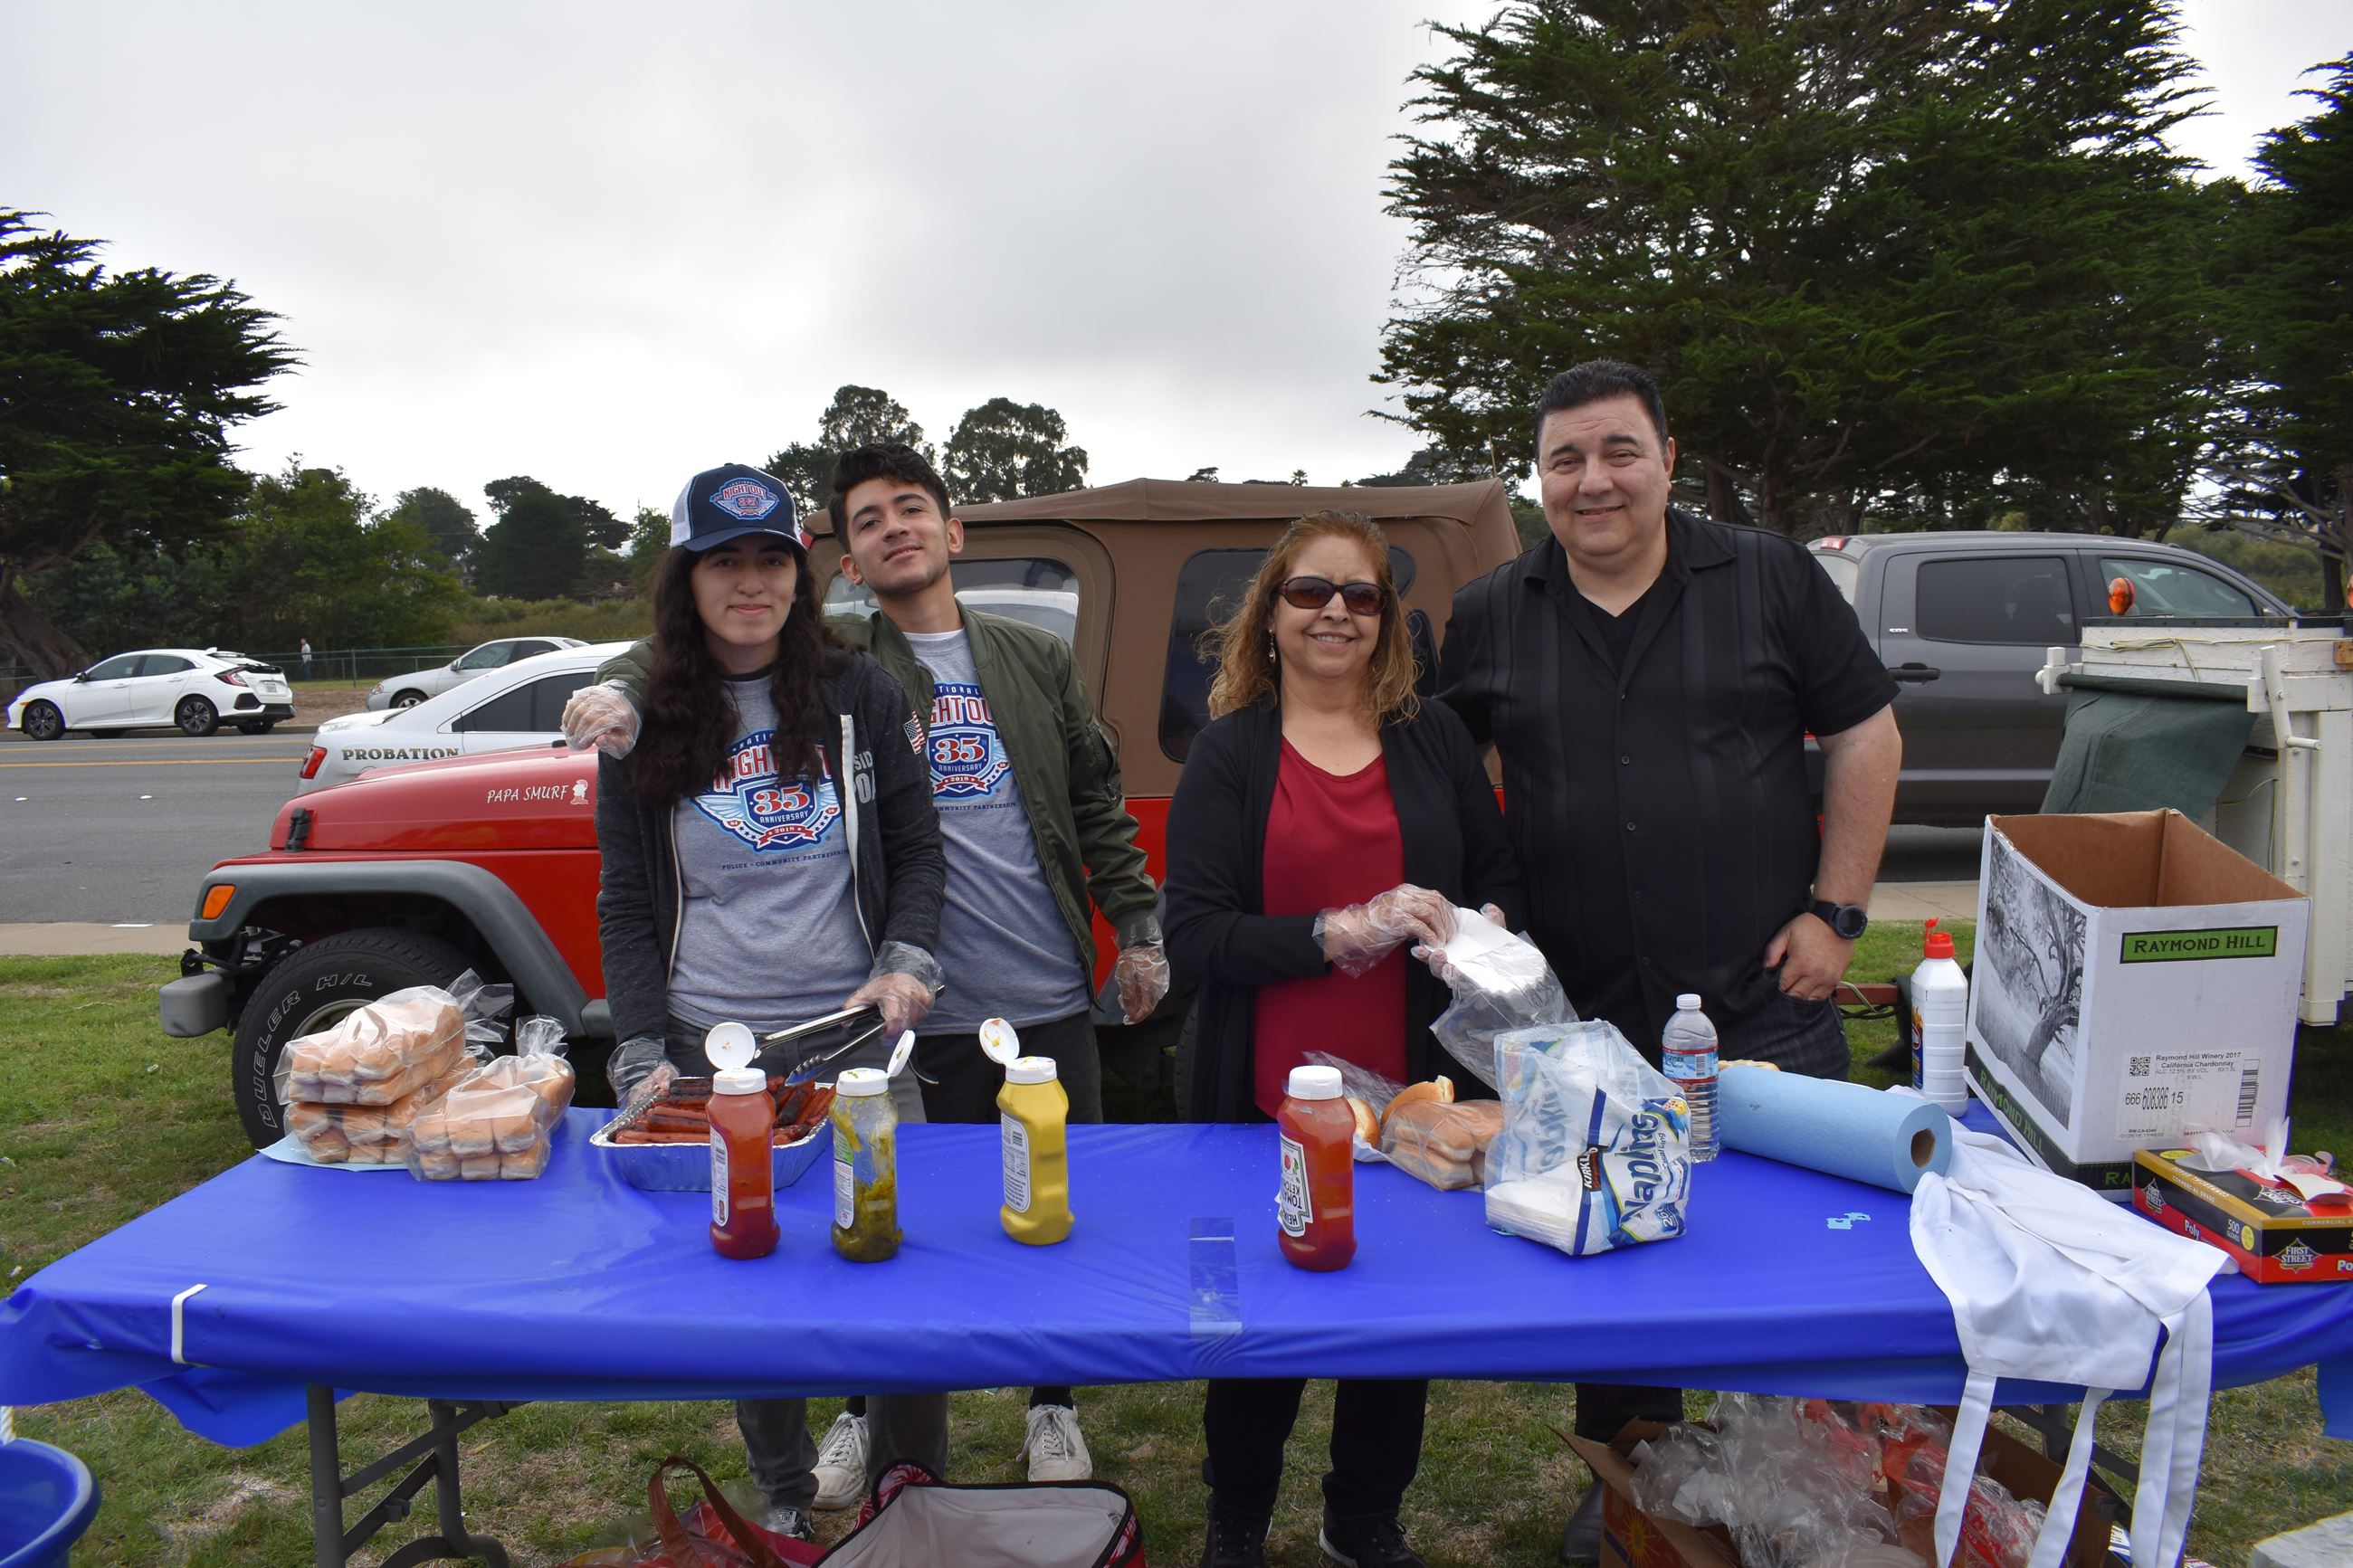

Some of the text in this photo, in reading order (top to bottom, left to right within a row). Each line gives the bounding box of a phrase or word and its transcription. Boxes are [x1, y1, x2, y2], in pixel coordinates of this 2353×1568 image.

[723, 484, 767, 500] NIGHT OUT
[938, 686, 979, 695] TIONAL
[929, 695, 995, 726] GHT OU
[341, 747, 459, 761] PROBATION
[935, 736, 985, 764] 35
[938, 763, 983, 773] ANNIVERSARY
[487, 784, 569, 803] PAPA SMURF
[753, 784, 810, 814] 35
[759, 810, 809, 824] ANNIVERSARY
[773, 825, 795, 834] 2018
[722, 862, 748, 870] POLICE
[755, 857, 800, 867] COMMUNITY
[2133, 935, 2266, 954] RAYMOND HILL
[253, 973, 373, 1128] DUELER H/L
[2194, 1060, 2234, 1069] Chardonnay
[2125, 1087, 2184, 1110] 666 608386 15
[1979, 1069, 2045, 1155] RAYMOND HILL
[2146, 1191, 2163, 1207] STREET
[2148, 1183, 2160, 1199] FIRST
[2184, 1219, 2200, 1240] Poly
[2227, 1219, 2240, 1234] 500
[2285, 1245, 2310, 1255] FIRST
[2281, 1254, 2313, 1263] STREET
[2337, 1259, 2353, 1272] Po
